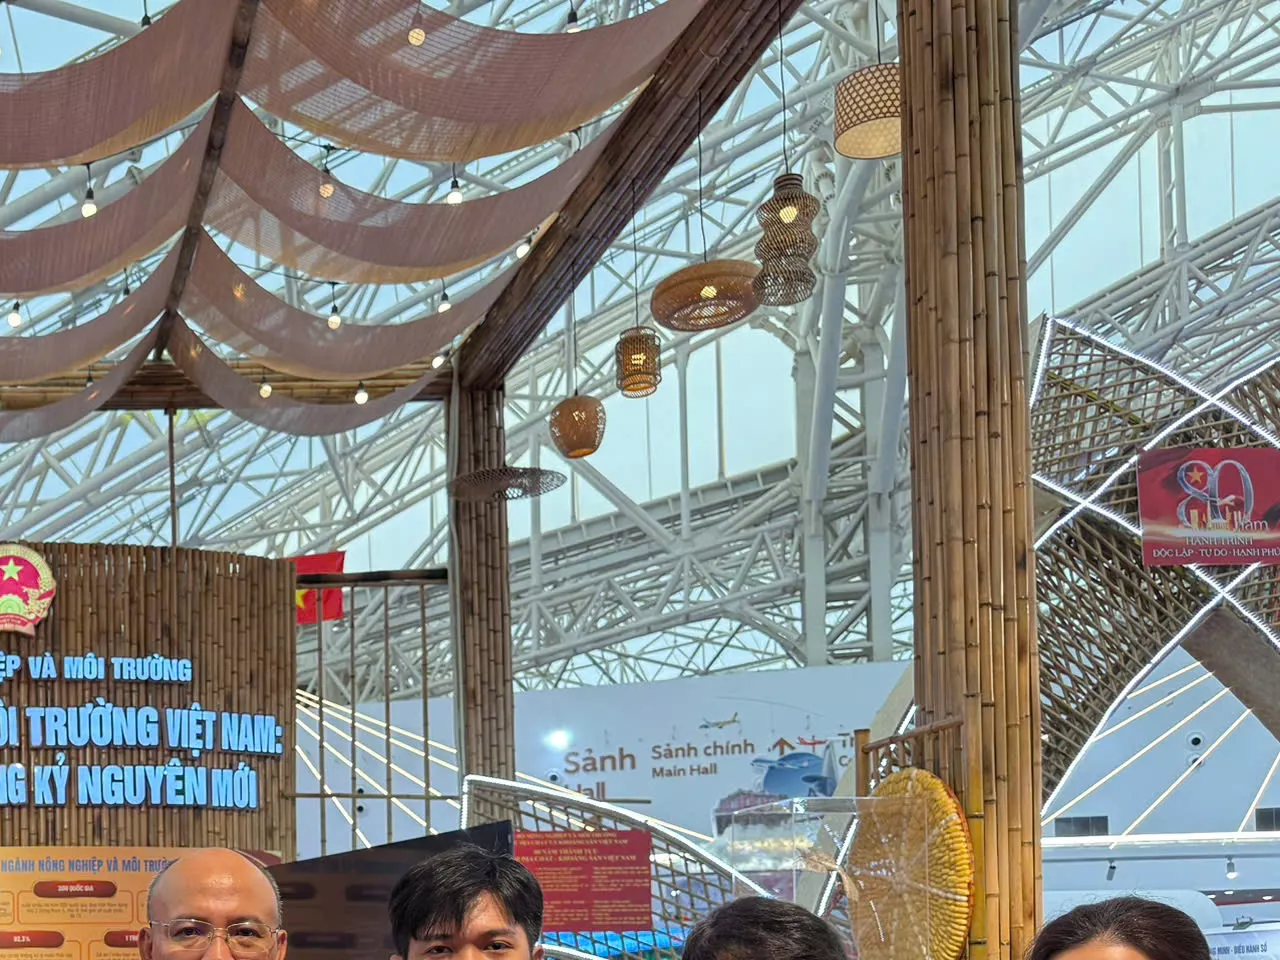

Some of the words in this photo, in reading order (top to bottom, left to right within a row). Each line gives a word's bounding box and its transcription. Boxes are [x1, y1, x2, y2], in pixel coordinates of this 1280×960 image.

[28, 652, 57, 680] VÀ
[64, 652, 105, 680] MÔI
[111, 653, 193, 682] TRƯỜNG
[25, 697, 159, 747] TRƯỜNG
[166, 702, 217, 757] VIỆT
[221, 712, 283, 754] NAM:
[564, 748, 636, 775] Sảnh
[651, 744, 698, 760] Sảnh
[703, 739, 756, 758] chính
[652, 767, 685, 779] Main
[690, 763, 717, 776] Hall
[34, 752, 69, 805] KỶ
[77, 758, 207, 805] NGUYÊN
[211, 762, 257, 808] MỚI
[1, 857, 35, 873] NGÀNH
[38, 856, 65, 872] NÔNG
[68, 856, 104, 875] NGHIỆP
[106, 856, 119, 872] VÀ
[122, 856, 141, 872] MÔI
